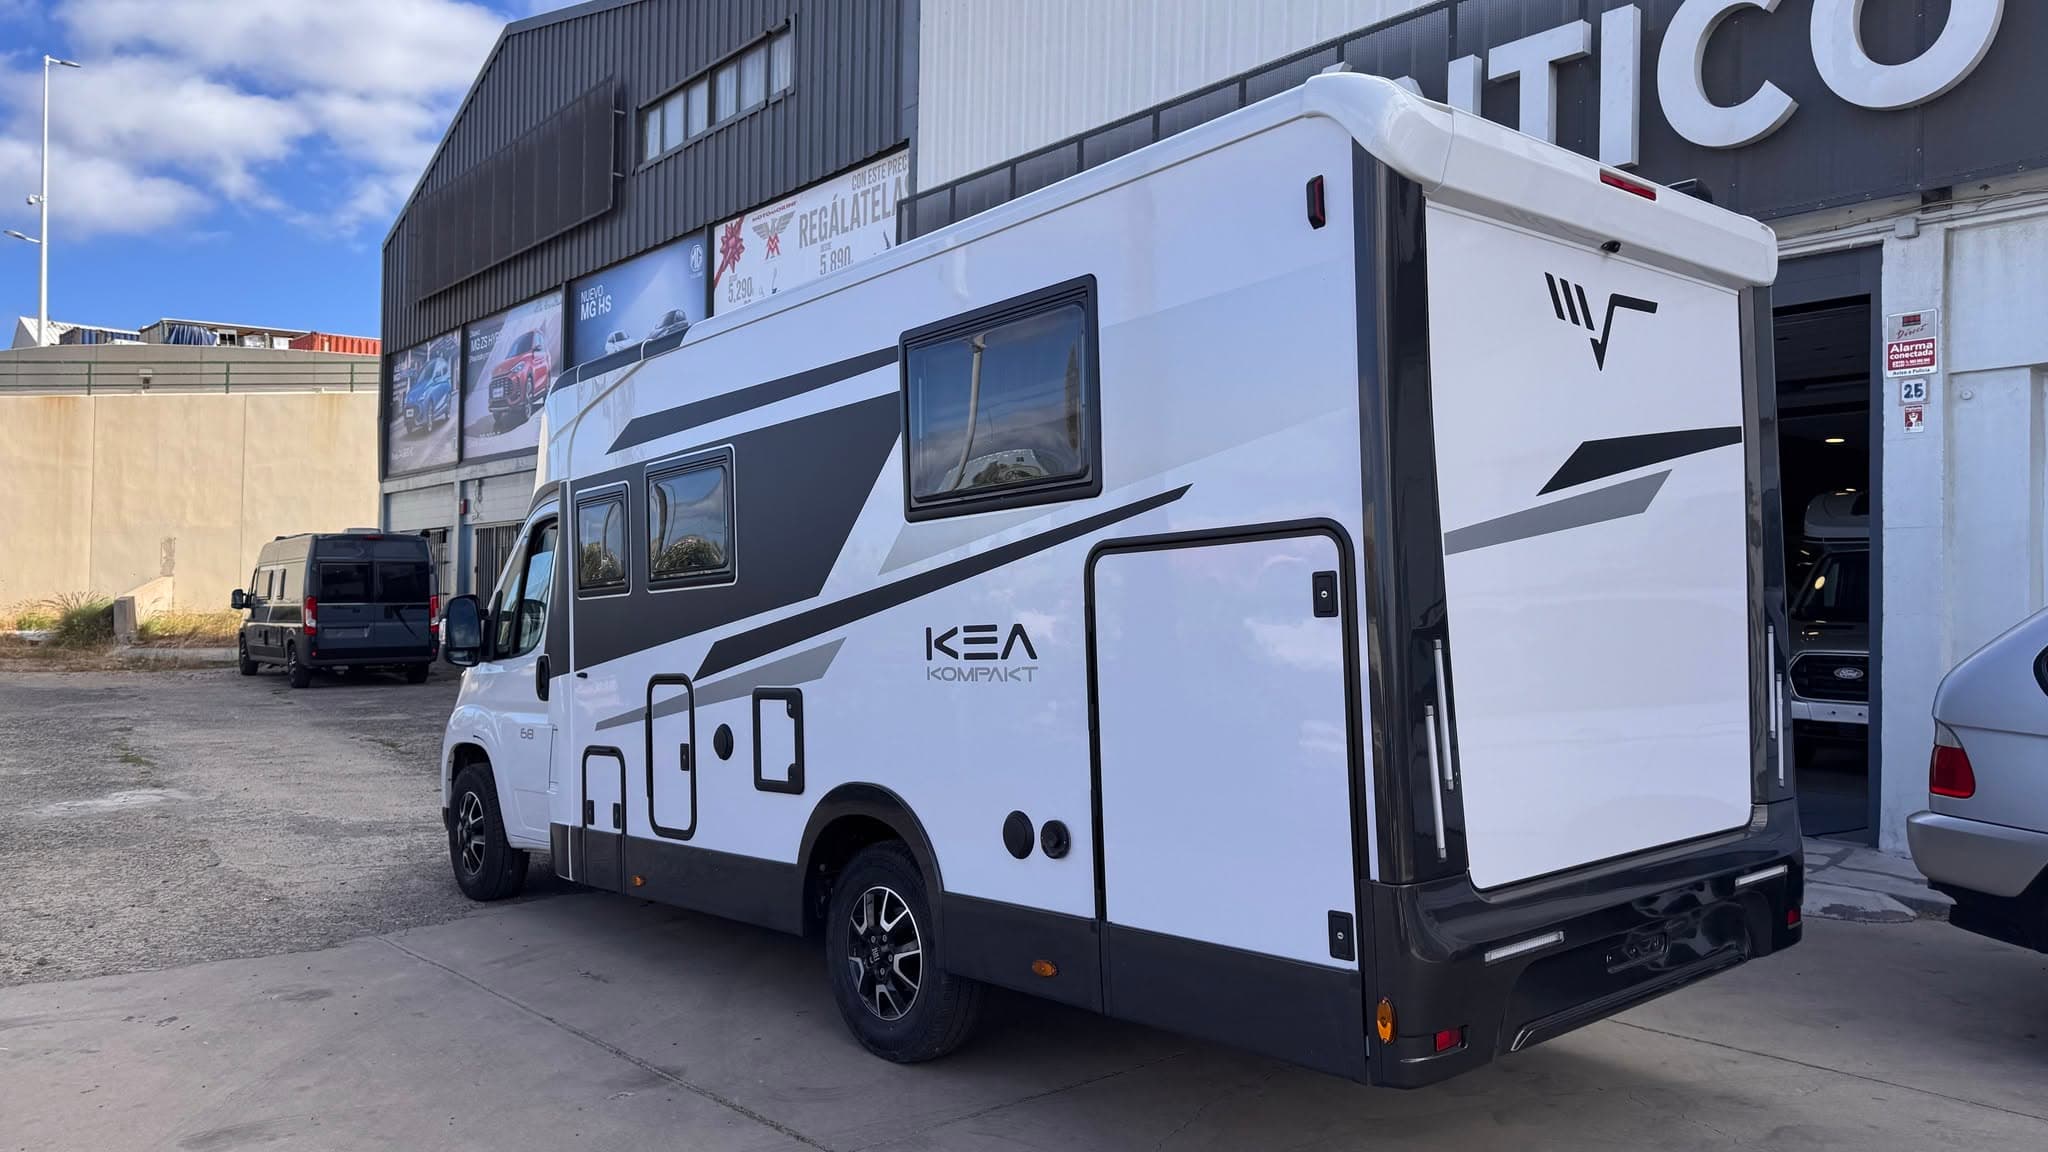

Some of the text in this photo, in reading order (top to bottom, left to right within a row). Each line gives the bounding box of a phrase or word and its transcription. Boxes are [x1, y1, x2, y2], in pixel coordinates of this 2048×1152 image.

[1322, 0, 2003, 168] TICO
[851, 172, 867, 191] CON
[868, 162, 887, 185] ESTE
[799, 174, 909, 249] REGÁLATELA
[581, 284, 604, 303] NUEVO
[580, 301, 597, 321] MG
[598, 294, 612, 315] HS
[1889, 349, 1933, 360] conectada
[1890, 343, 1933, 353] Alarma
[1903, 383, 1924, 399] 25
[926, 624, 1038, 661] KEA
[927, 666, 1039, 682] KOMPAKT
